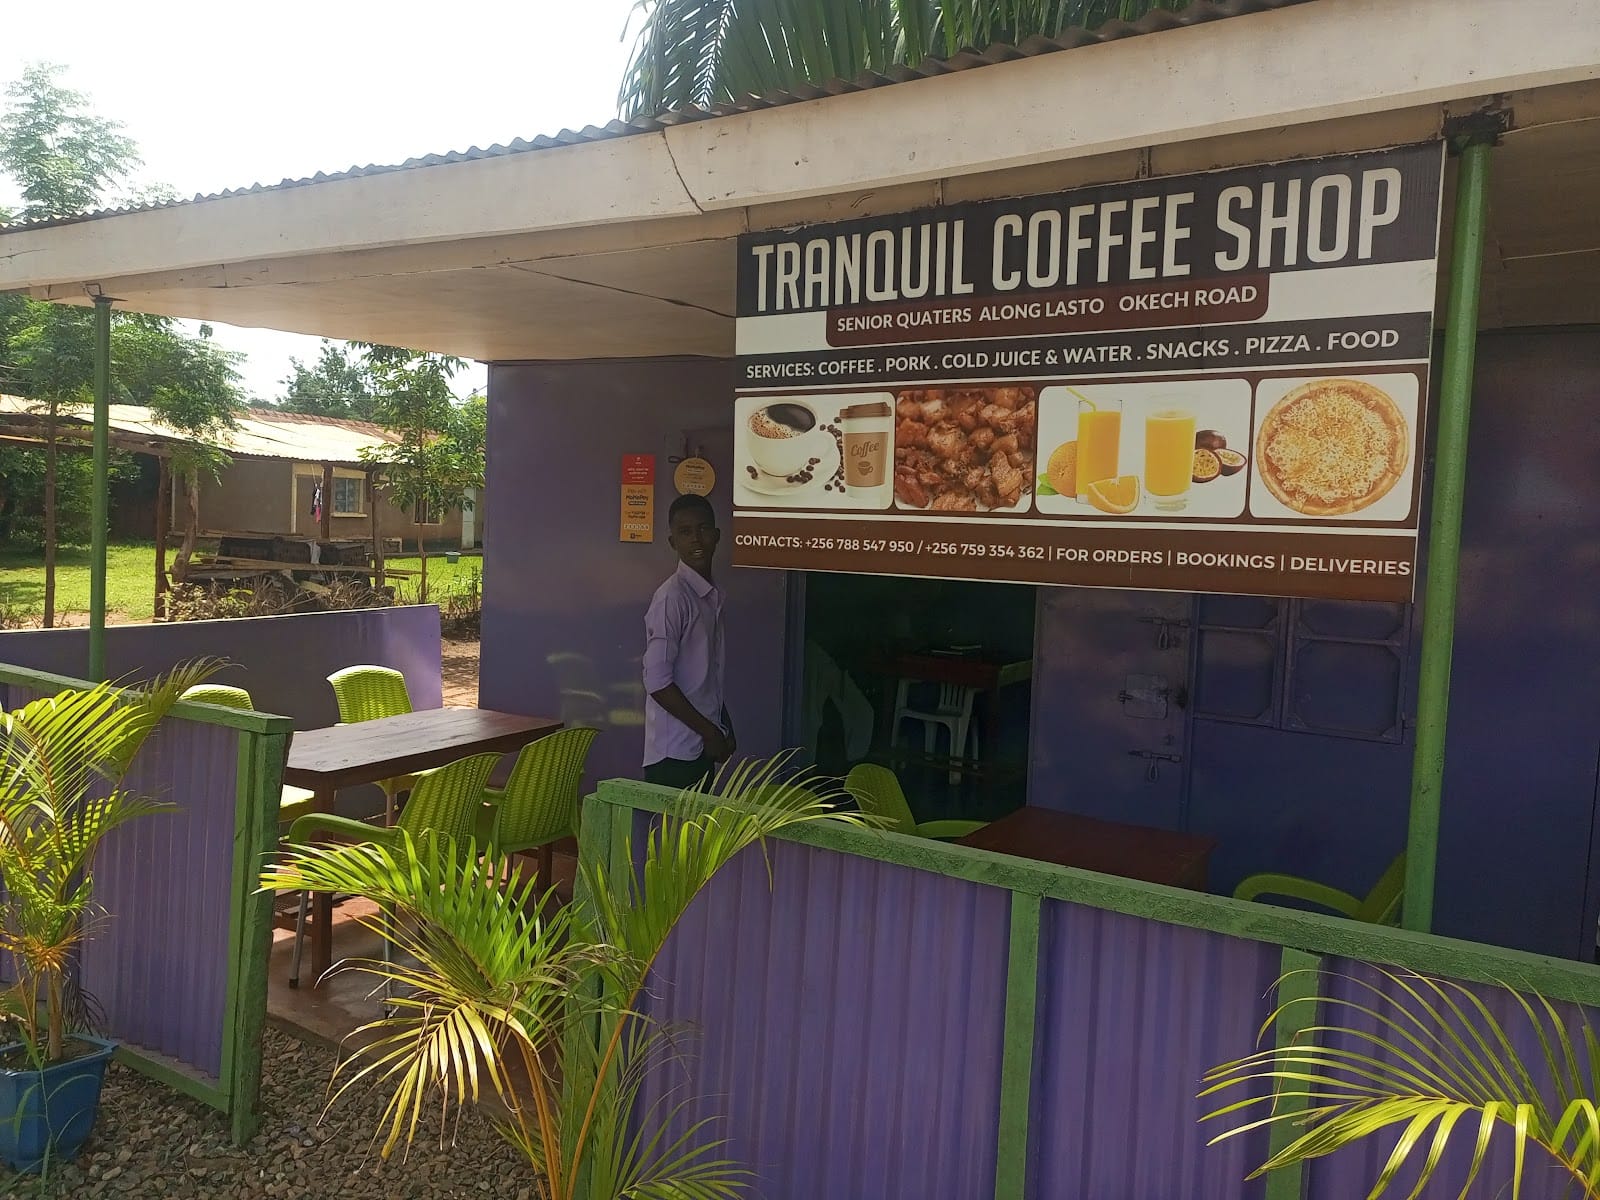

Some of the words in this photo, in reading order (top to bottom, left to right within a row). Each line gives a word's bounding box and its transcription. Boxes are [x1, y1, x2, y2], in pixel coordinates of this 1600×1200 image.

[752, 220, 974, 312] TRANQUIL
[992, 192, 1194, 291] COFFEE
[1214, 167, 1402, 272] SHOP
[837, 314, 893, 332] SENIOR
[896, 308, 972, 329] QUATERS
[978, 303, 1041, 322] ALONG
[1045, 298, 1105, 317] LASTO
[1119, 291, 1189, 312] OKECH
[1194, 286, 1258, 306] ROAD
[746, 362, 815, 379] SERVICES:
[941, 352, 989, 369] COLD
[991, 350, 1041, 367] JUICE
[1045, 349, 1059, 365] &
[1327, 329, 1399, 350] FOOD
[850, 441, 881, 459] Coffee
[735, 534, 803, 549] CONTACTS:
[805, 537, 834, 549] +256
[836, 538, 860, 551] 788
[862, 539, 887, 552] 547
[889, 540, 914, 553] 950
[925, 542, 957, 555] +256
[960, 543, 986, 556] 759
[988, 544, 1015, 557] 354
[1017, 546, 1044, 559] 362
[1056, 548, 1089, 562] FOR
[1092, 549, 1163, 564] ORDERS
[1176, 551, 1275, 569] BOOKINGS
[1290, 556, 1411, 576] DELIVERIES
